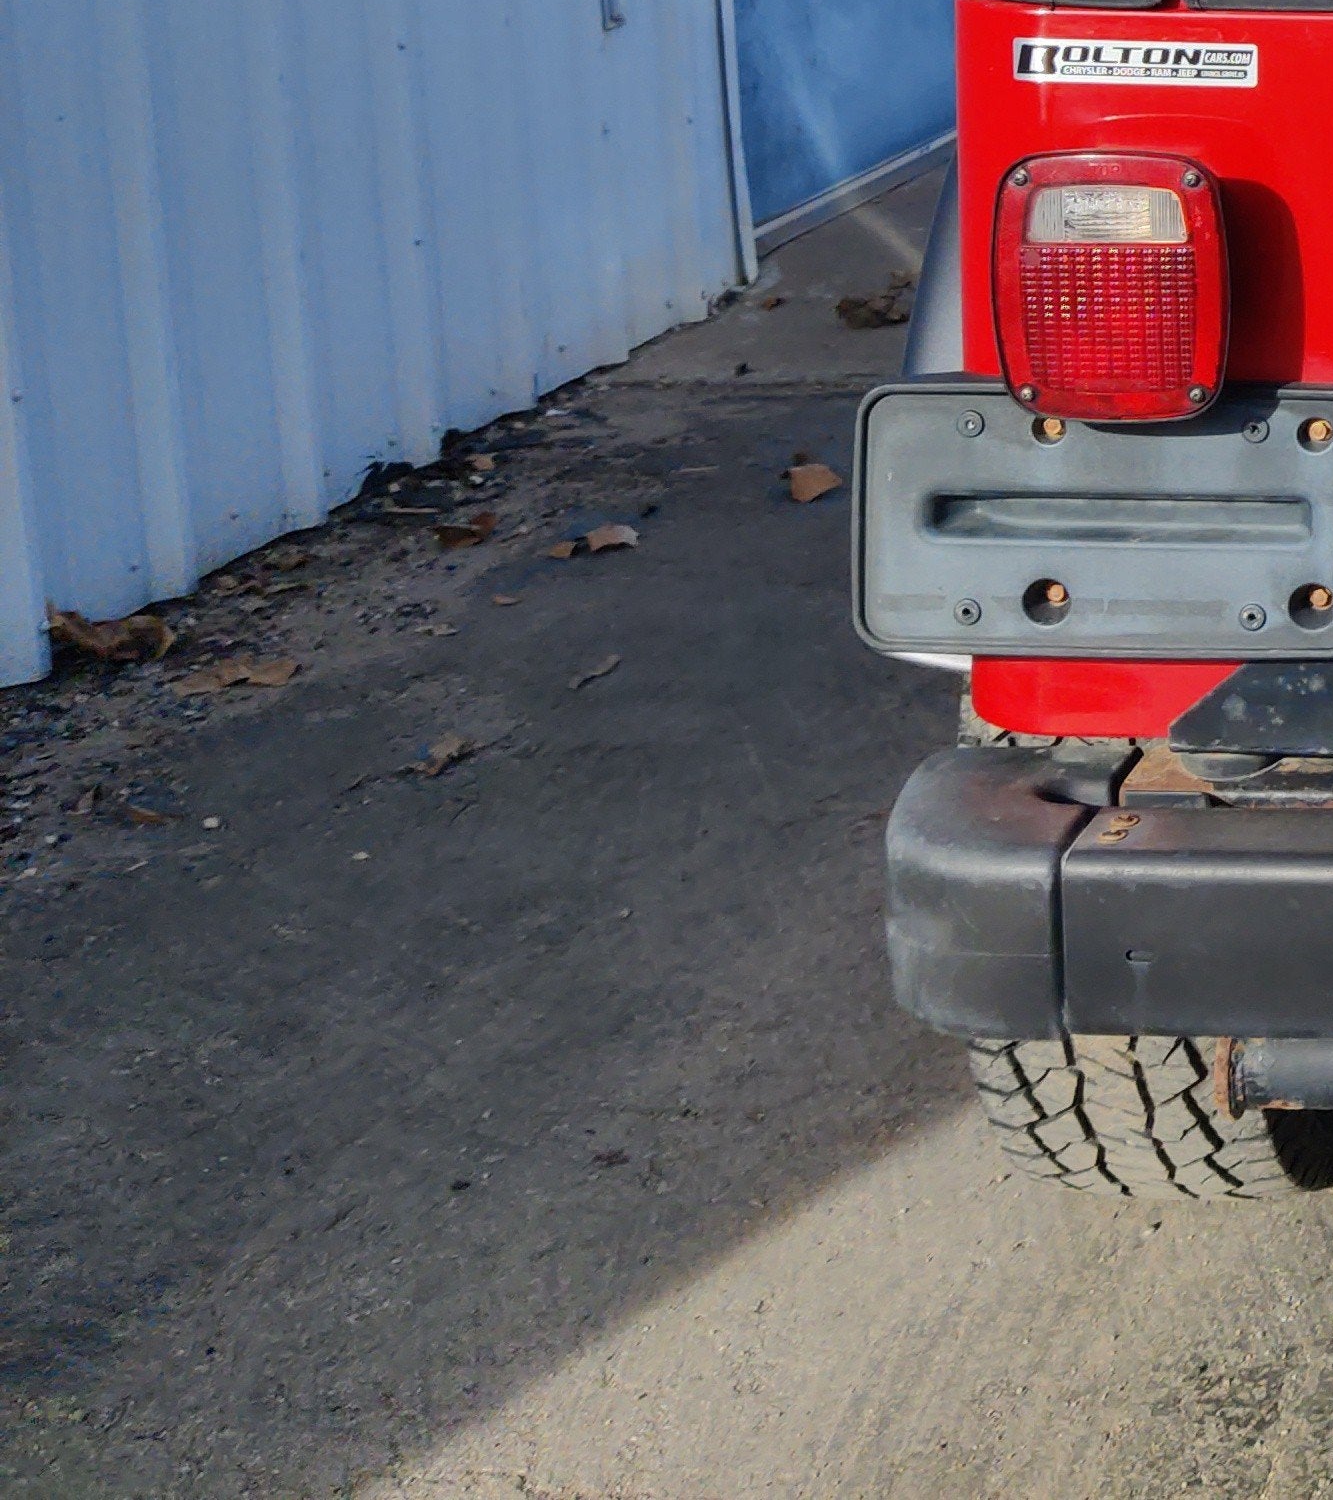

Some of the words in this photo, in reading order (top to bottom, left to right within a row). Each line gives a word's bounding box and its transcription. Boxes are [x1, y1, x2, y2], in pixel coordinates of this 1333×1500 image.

[1063, 65, 1108, 76] CHRYSLER
[1112, 67, 1146, 77] DODGE
[1151, 68, 1172, 77] RAM
[1177, 69, 1198, 78] JEEP
